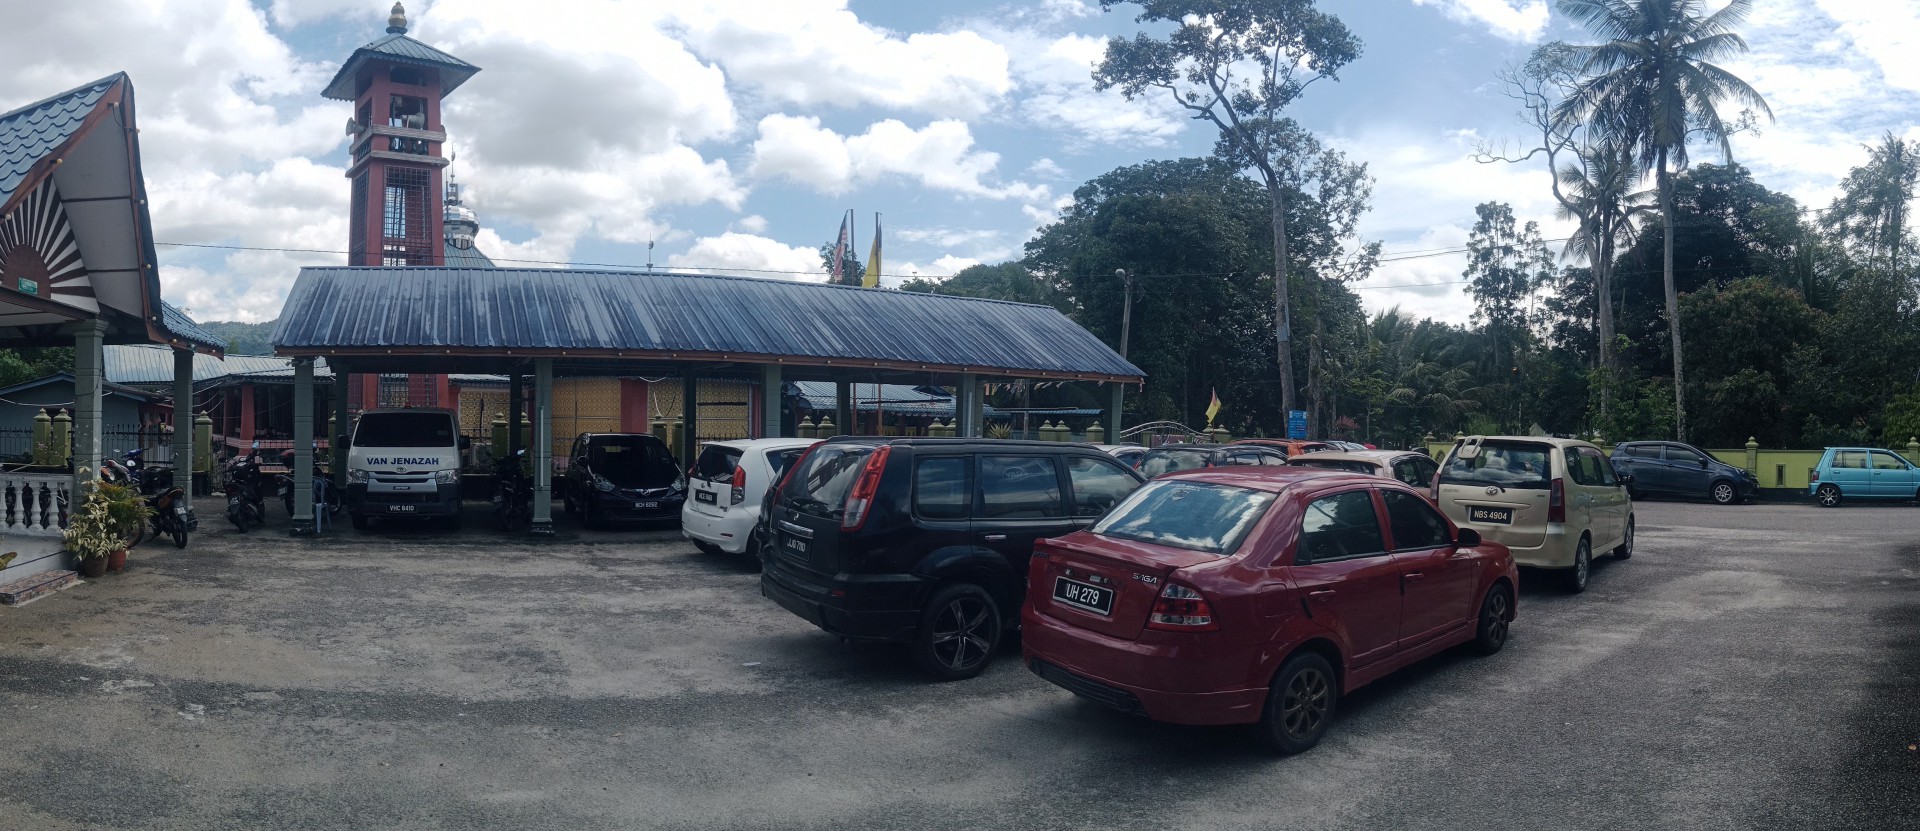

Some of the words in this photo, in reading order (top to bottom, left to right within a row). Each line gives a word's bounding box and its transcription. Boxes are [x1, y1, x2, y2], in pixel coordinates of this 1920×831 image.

[366, 457, 388, 465] VAN
[390, 457, 440, 465] JENAZAH
[1473, 510, 1488, 519] NBS
[1488, 511, 1508, 520] 4904
[1132, 572, 1158, 584] SAGA
[1066, 583, 1080, 600] UH
[1080, 587, 1100, 605] 279
